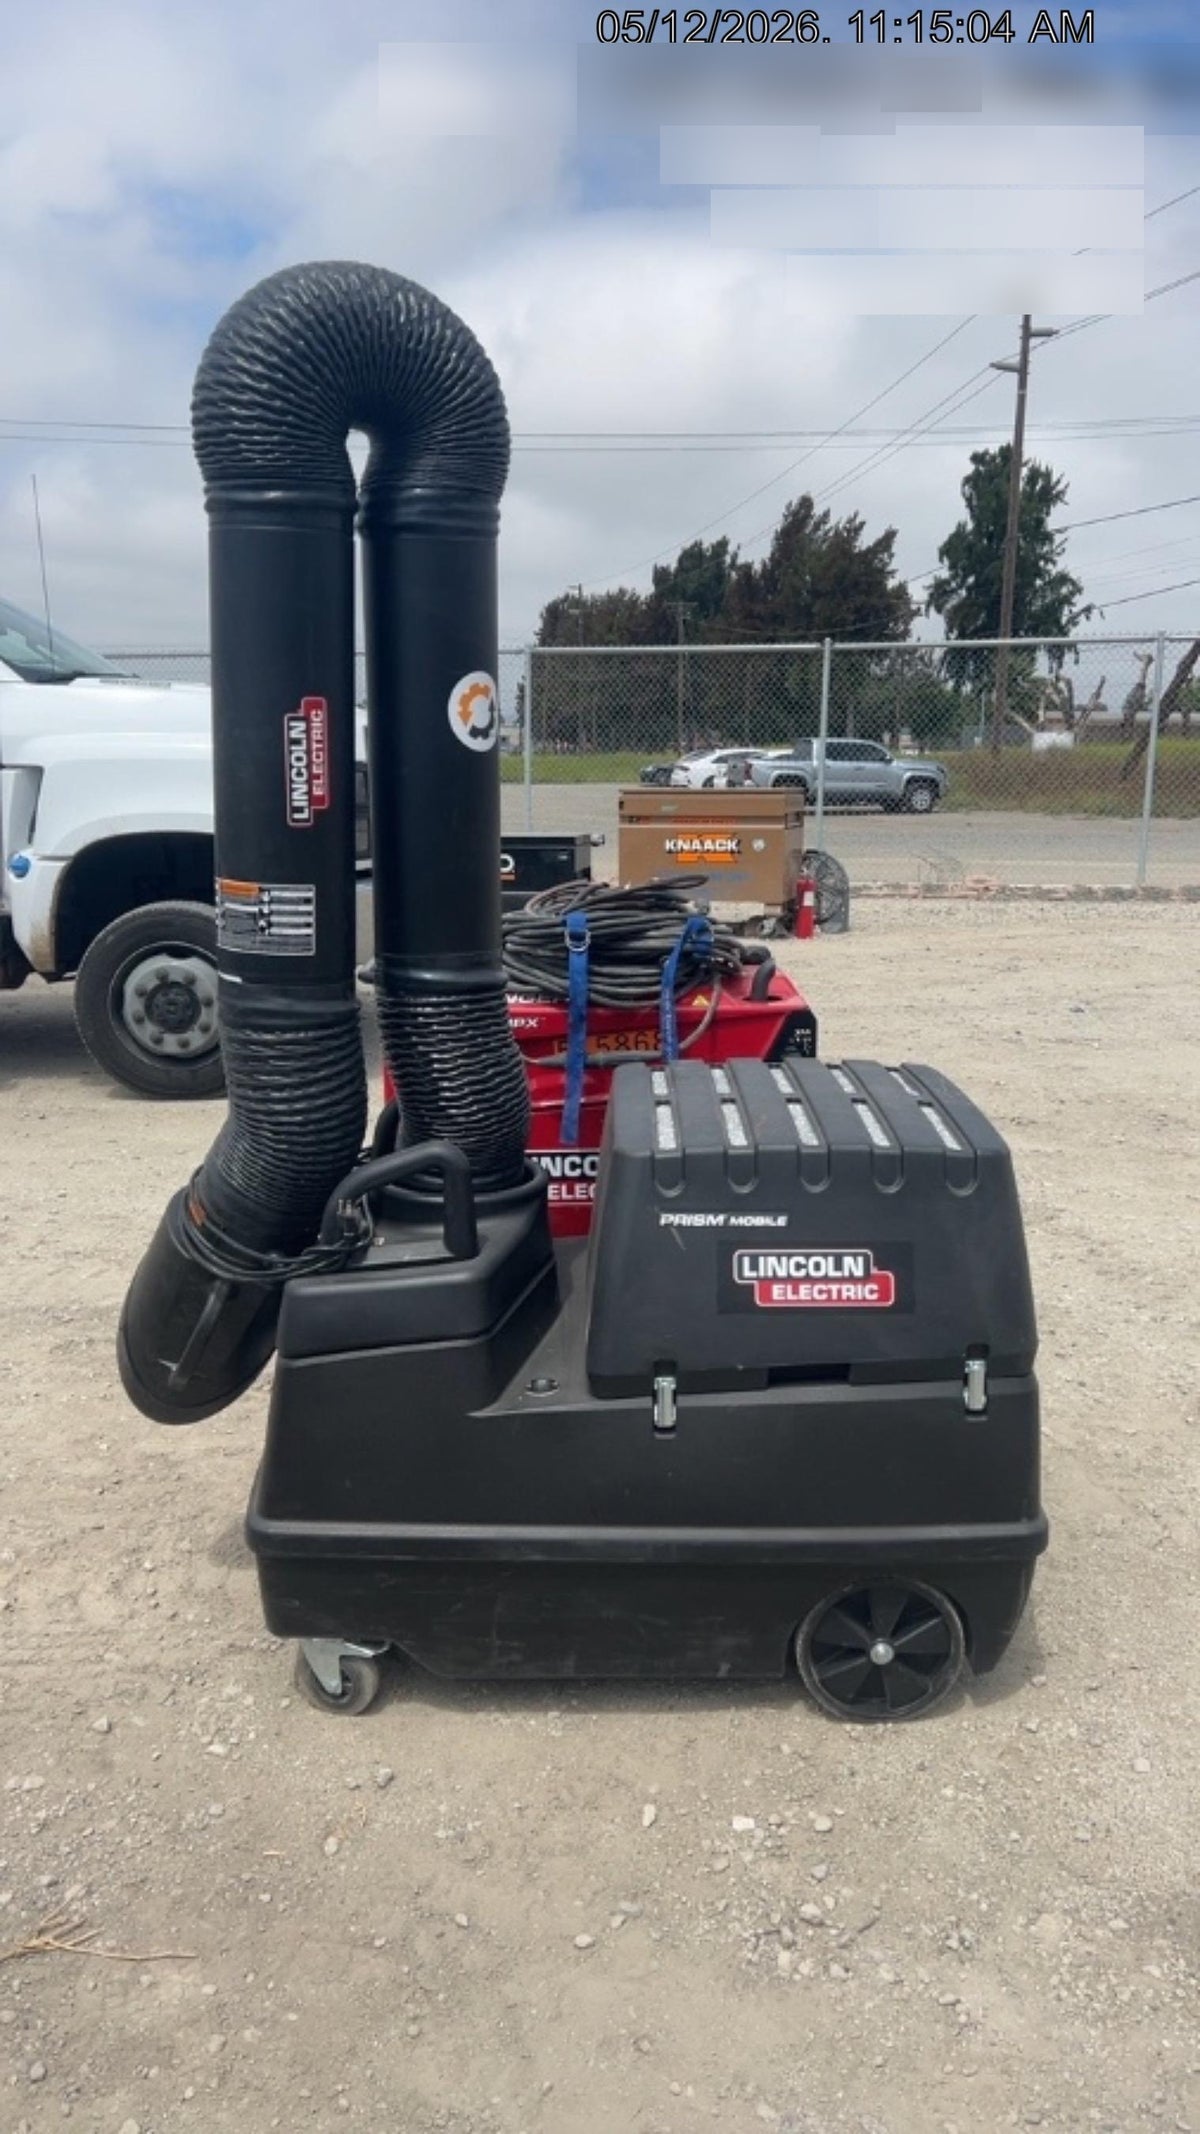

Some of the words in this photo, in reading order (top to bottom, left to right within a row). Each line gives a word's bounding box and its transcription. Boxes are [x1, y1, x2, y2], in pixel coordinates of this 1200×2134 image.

[310, 708, 324, 796] ELECTRIC
[289, 720, 309, 819] LINCOLN
[665, 838, 740, 853] KNAACK
[660, 1213, 726, 1227] PRISM
[728, 1215, 788, 1227] MOBILE
[741, 1256, 864, 1278] LINCOLN
[771, 1283, 879, 1300] ELECTRIC
